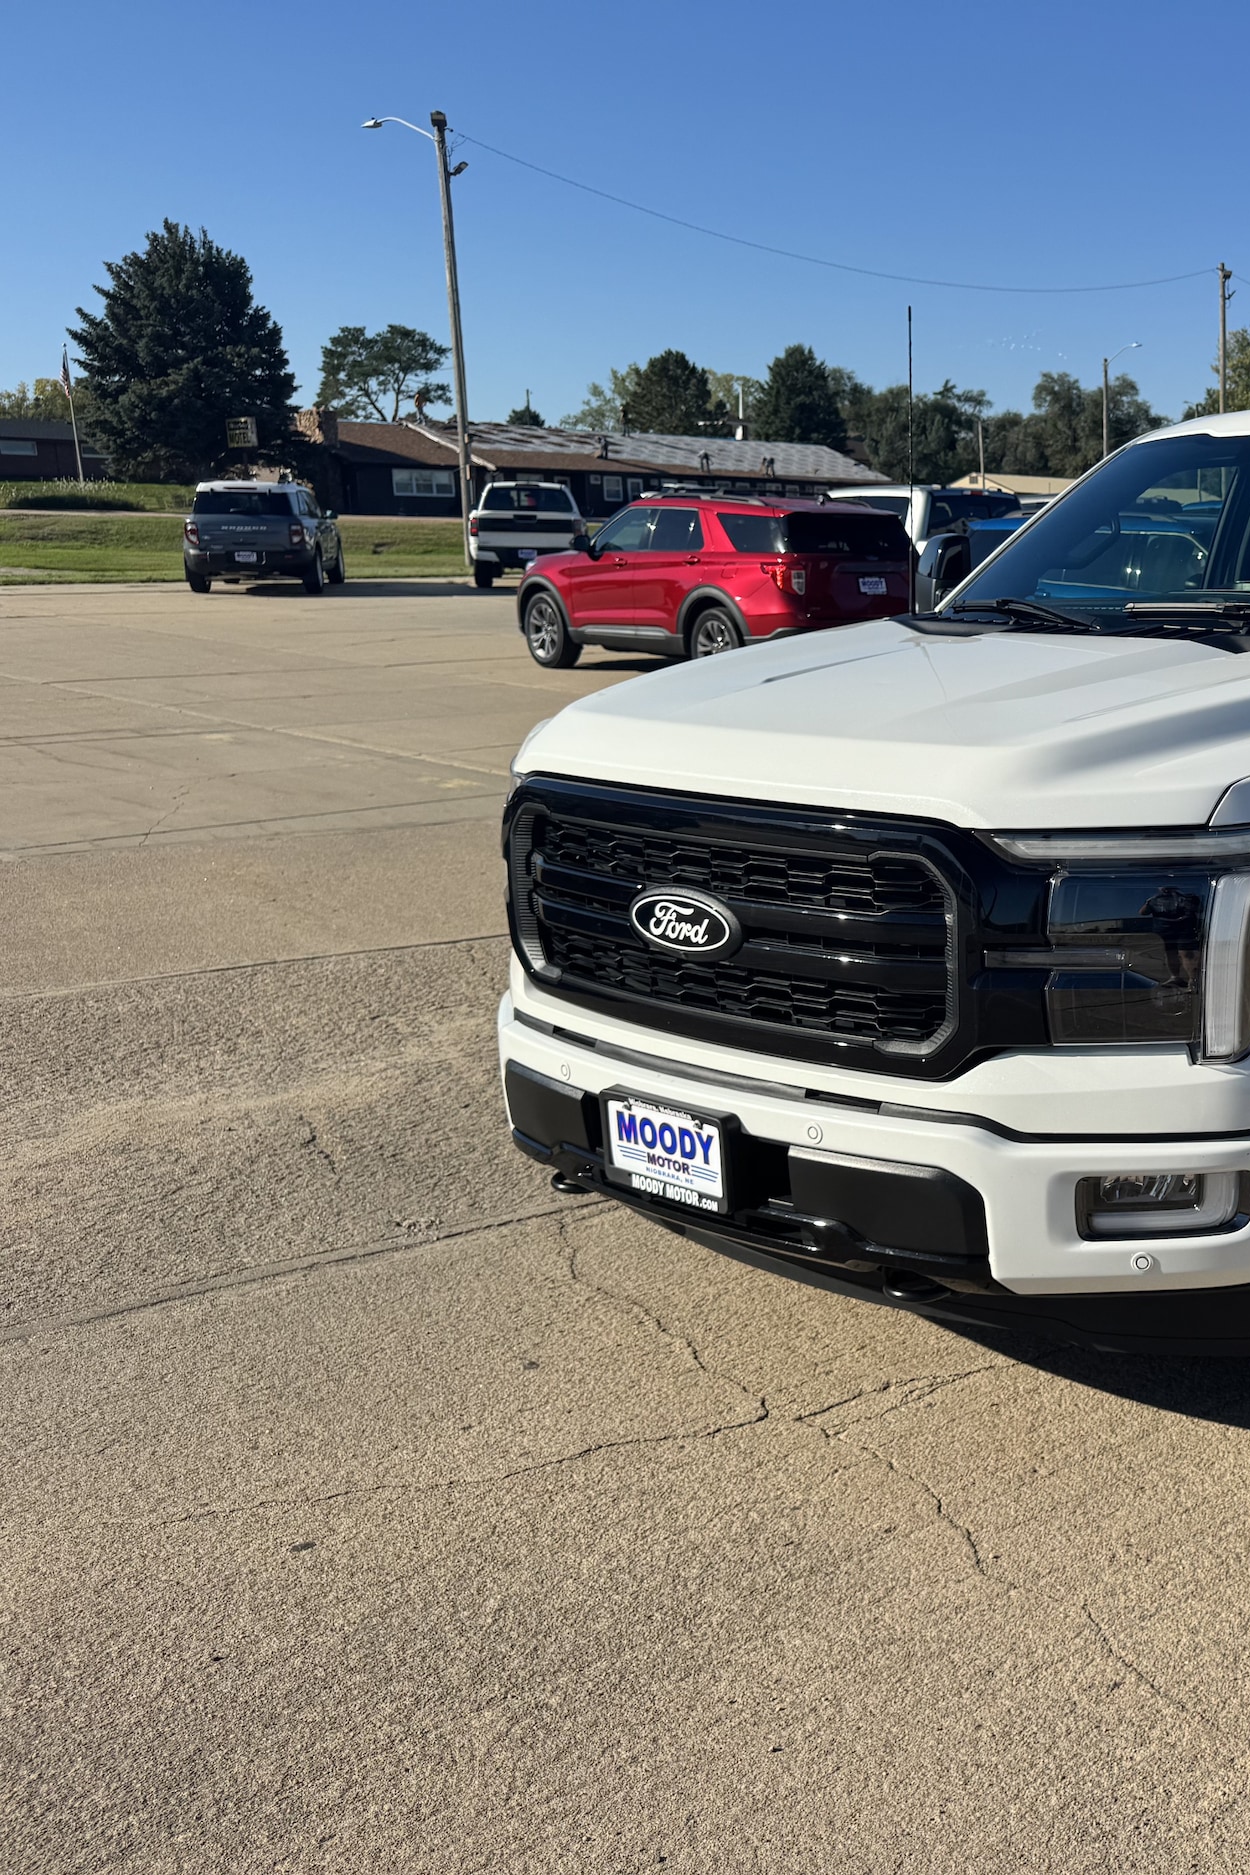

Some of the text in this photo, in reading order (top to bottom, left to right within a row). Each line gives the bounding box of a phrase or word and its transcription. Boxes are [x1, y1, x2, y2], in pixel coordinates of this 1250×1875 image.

[650, 902, 709, 944] Ford
[616, 1110, 714, 1165] MOODY
[647, 1152, 691, 1175] MOTOR
[632, 1174, 664, 1196] MOODY
